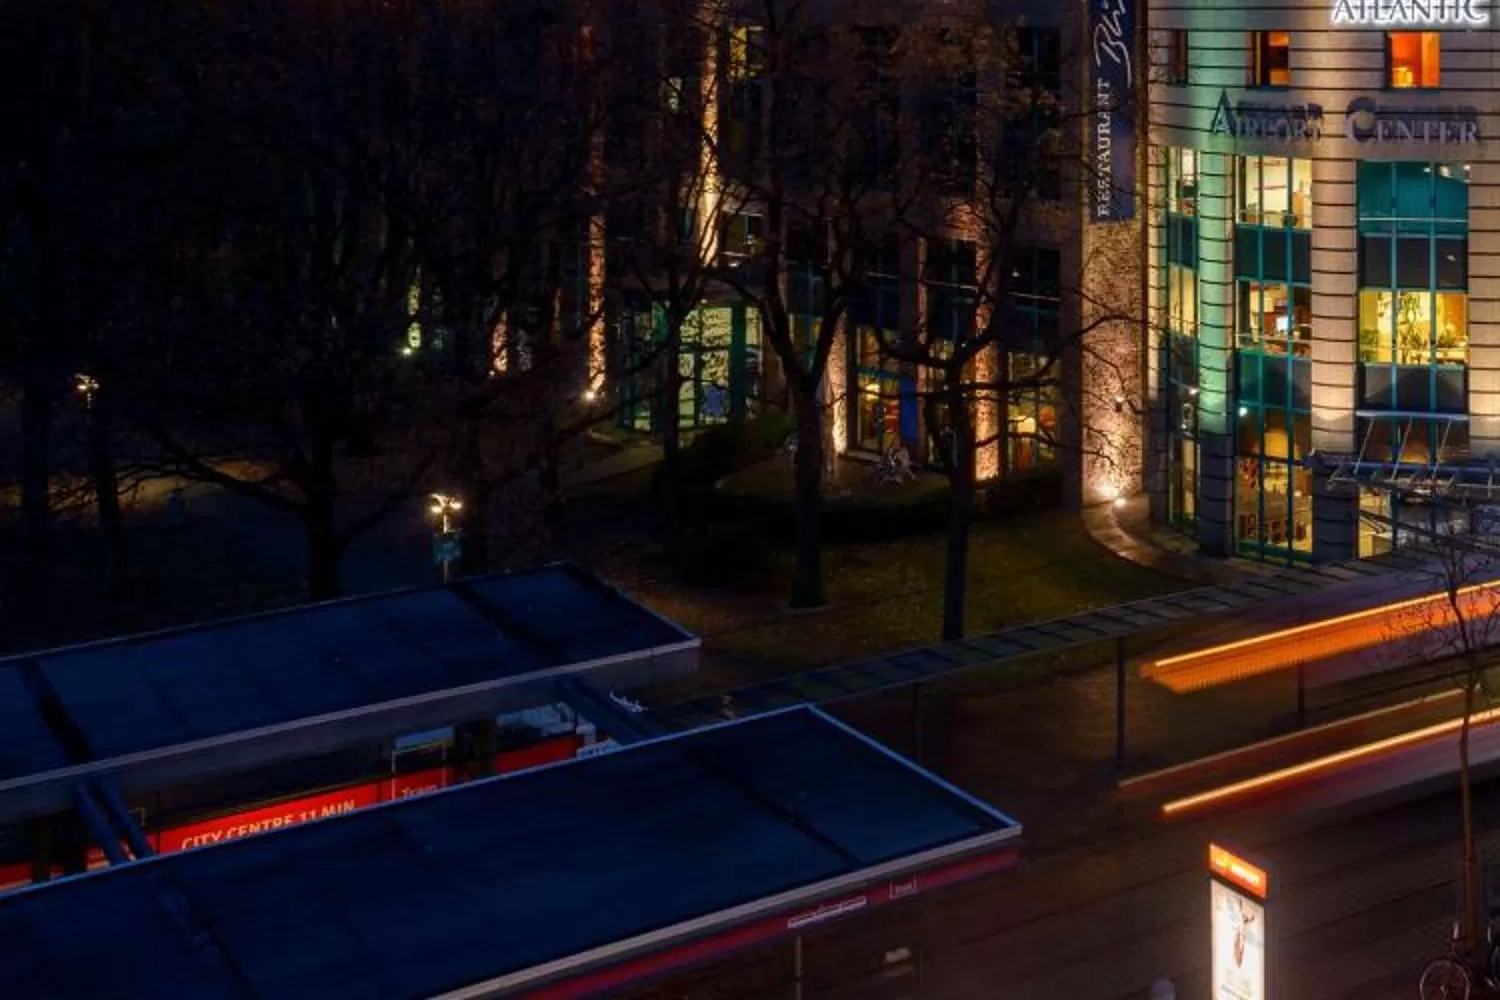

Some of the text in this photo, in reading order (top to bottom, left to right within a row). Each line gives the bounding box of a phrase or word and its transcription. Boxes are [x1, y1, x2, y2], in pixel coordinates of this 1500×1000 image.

[1097, 78, 1111, 217] RESTAURANT
[181, 830, 222, 851] CITY
[321, 799, 355, 818] MIN
